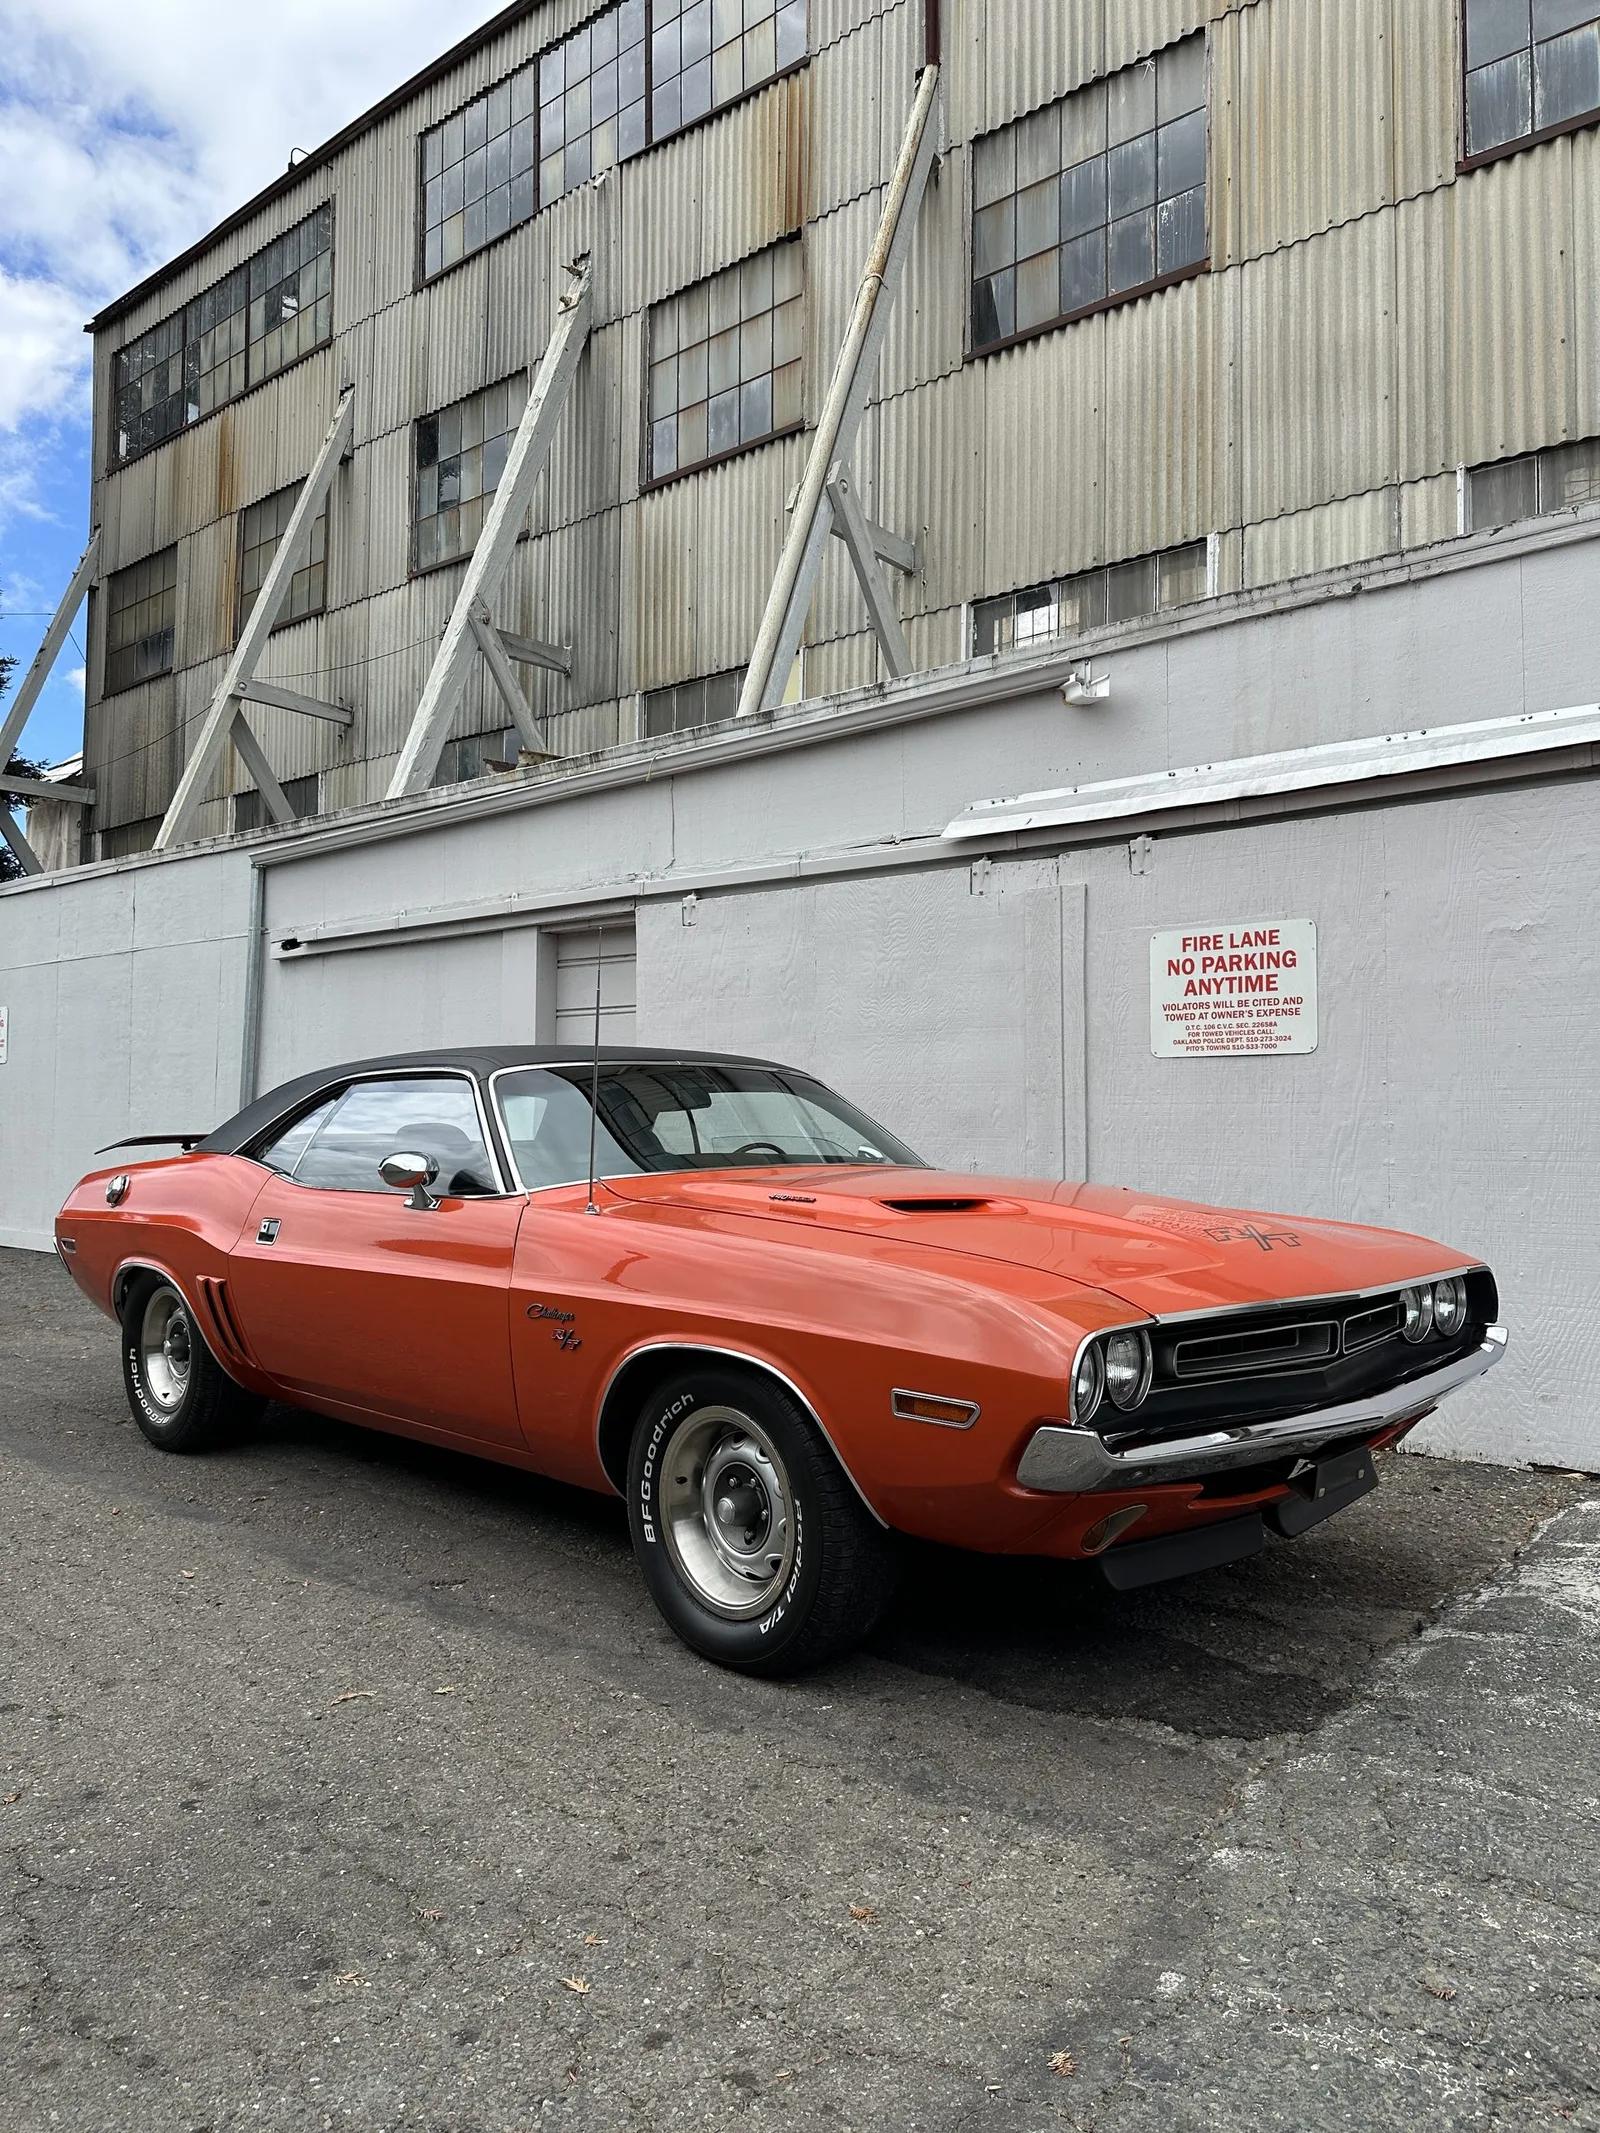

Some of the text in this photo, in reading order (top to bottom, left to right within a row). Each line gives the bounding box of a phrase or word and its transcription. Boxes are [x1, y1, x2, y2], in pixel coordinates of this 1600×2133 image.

[1182, 929, 1280, 952] FIRE LANE
[1167, 950, 1297, 976] NO PARKING
[1184, 973, 1279, 996] ANYTIME
[1162, 996, 1303, 1012] VIOLATORS WILL BE CITED AND
[1164, 1007, 1301, 1022] TOWED AT OWNER'S EXPENSE
[551, 1328, 582, 1350] R/T
[640, 1392, 695, 1544] BFGoodrich
[758, 1498, 803, 1635] Radial T/A
